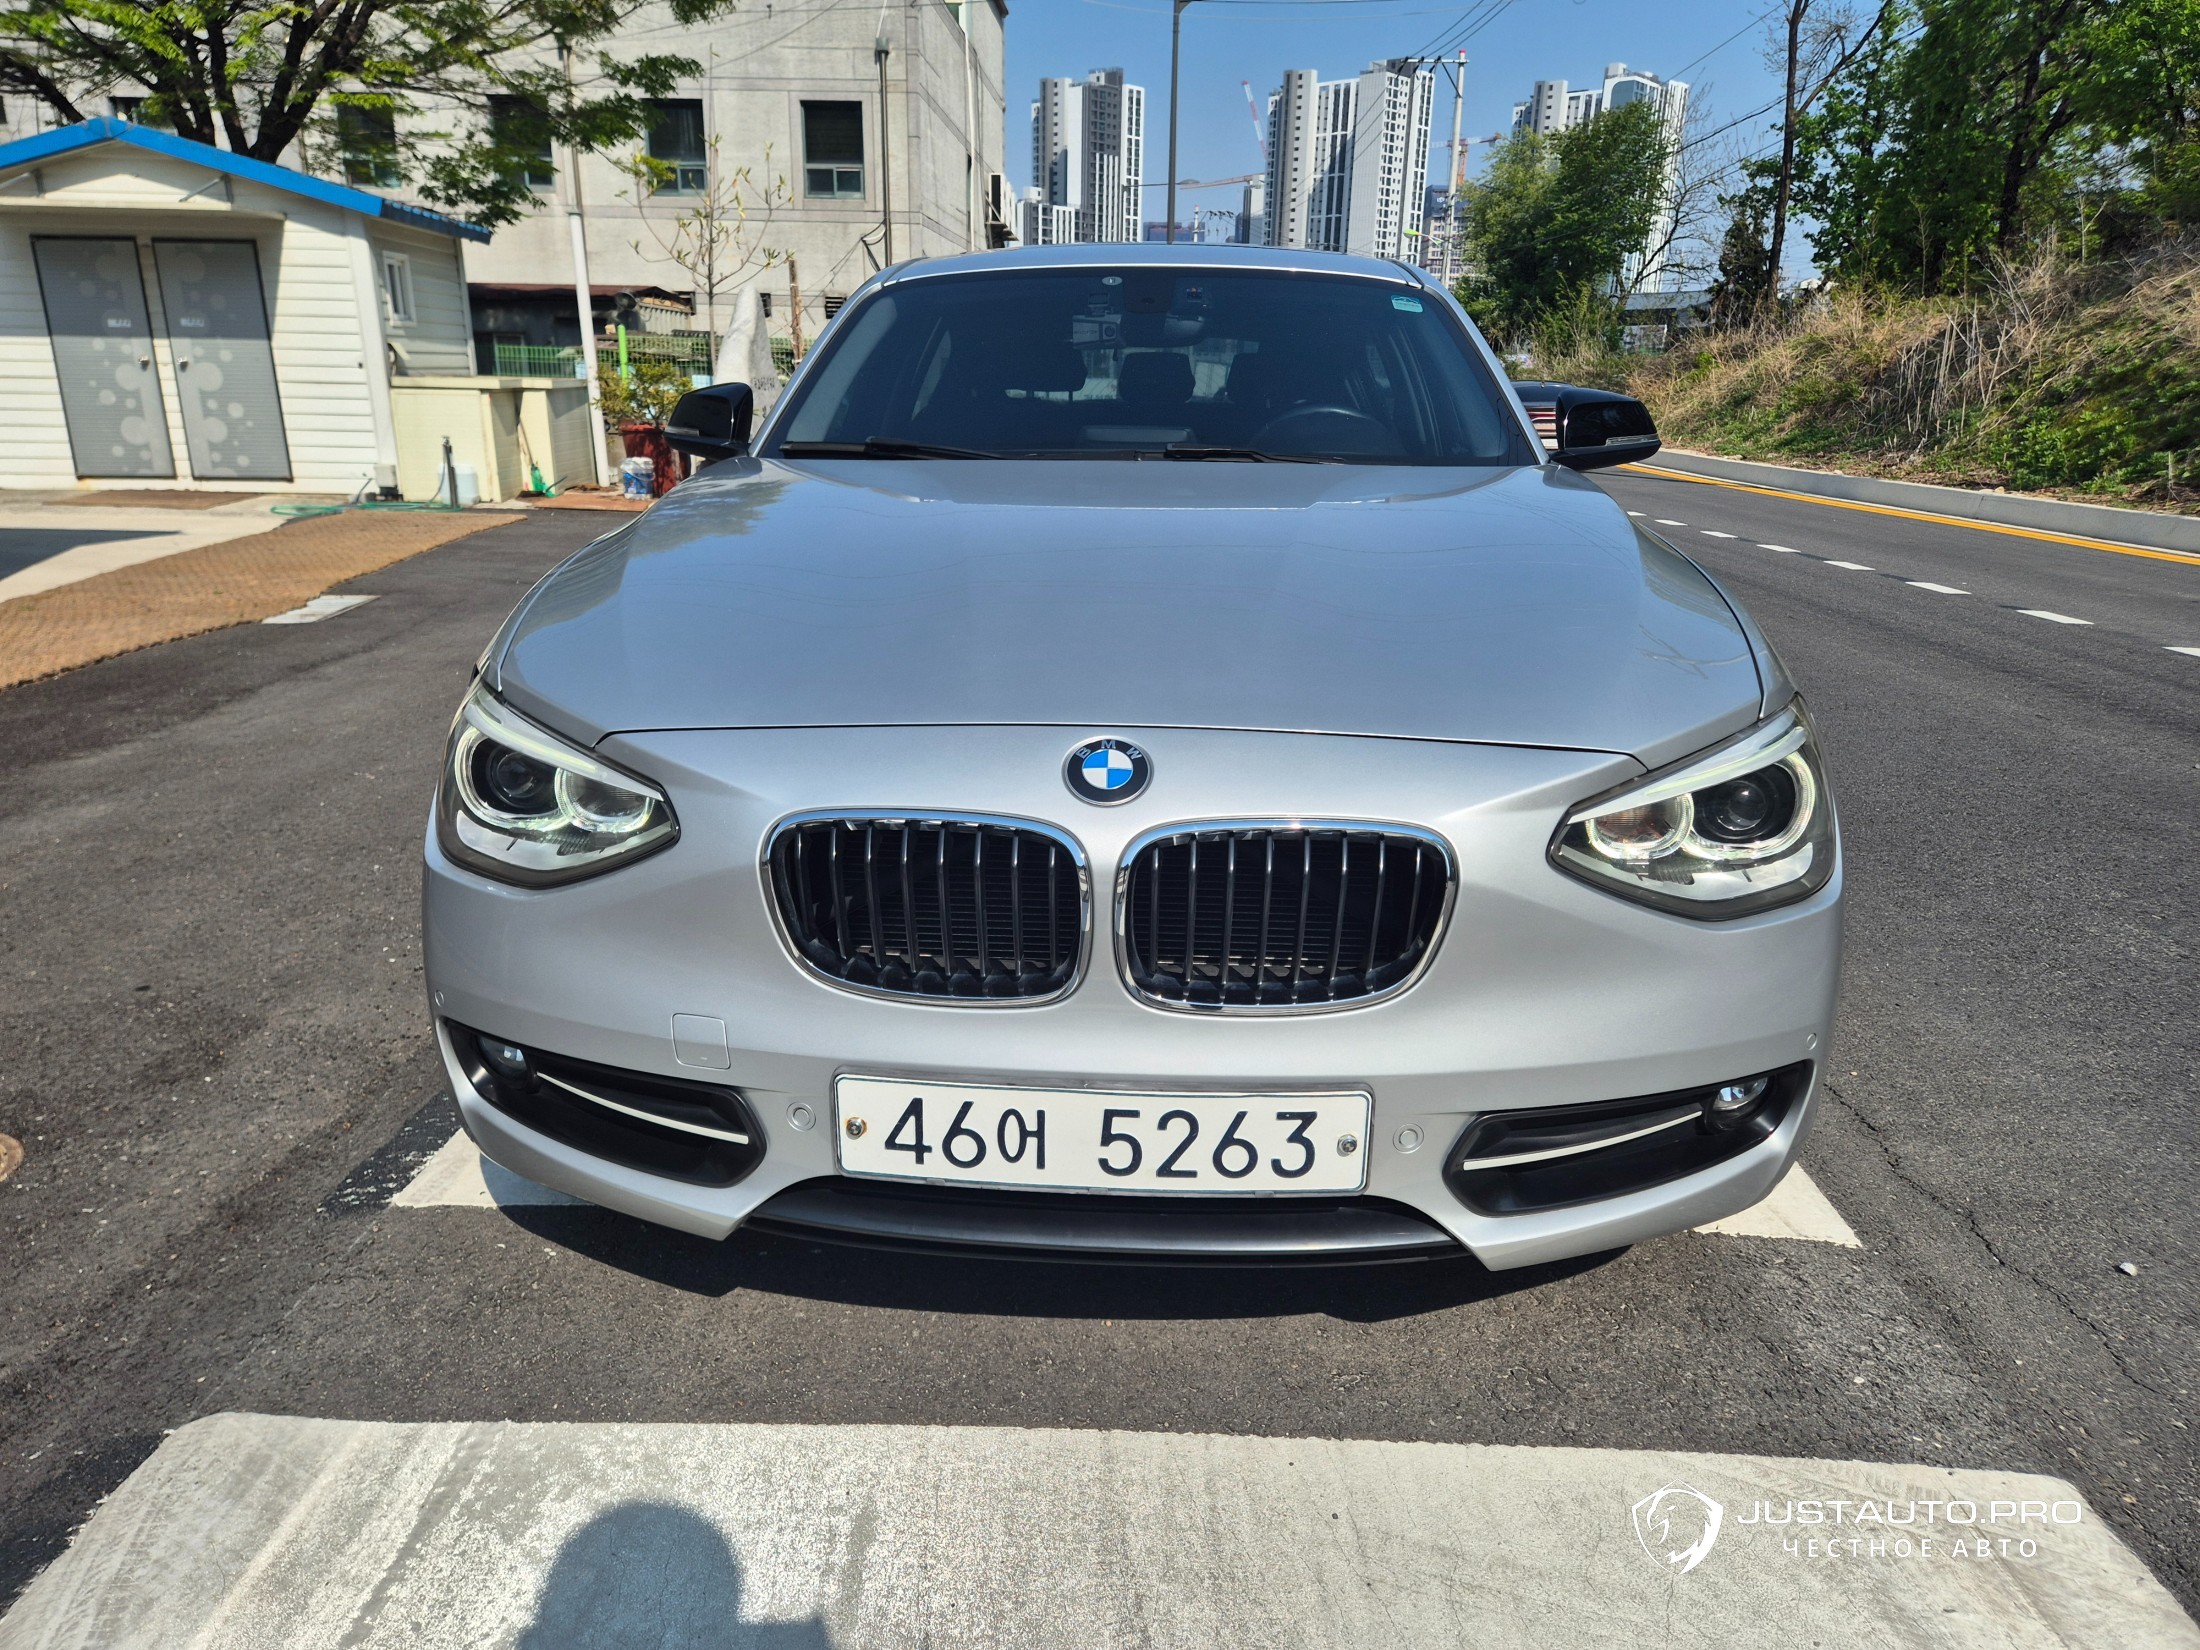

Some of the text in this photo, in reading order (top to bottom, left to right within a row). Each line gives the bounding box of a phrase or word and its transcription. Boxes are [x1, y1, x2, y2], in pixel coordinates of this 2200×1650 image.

[1075, 738, 1142, 760] BMW
[884, 1097, 1318, 1179] 46어 5263
